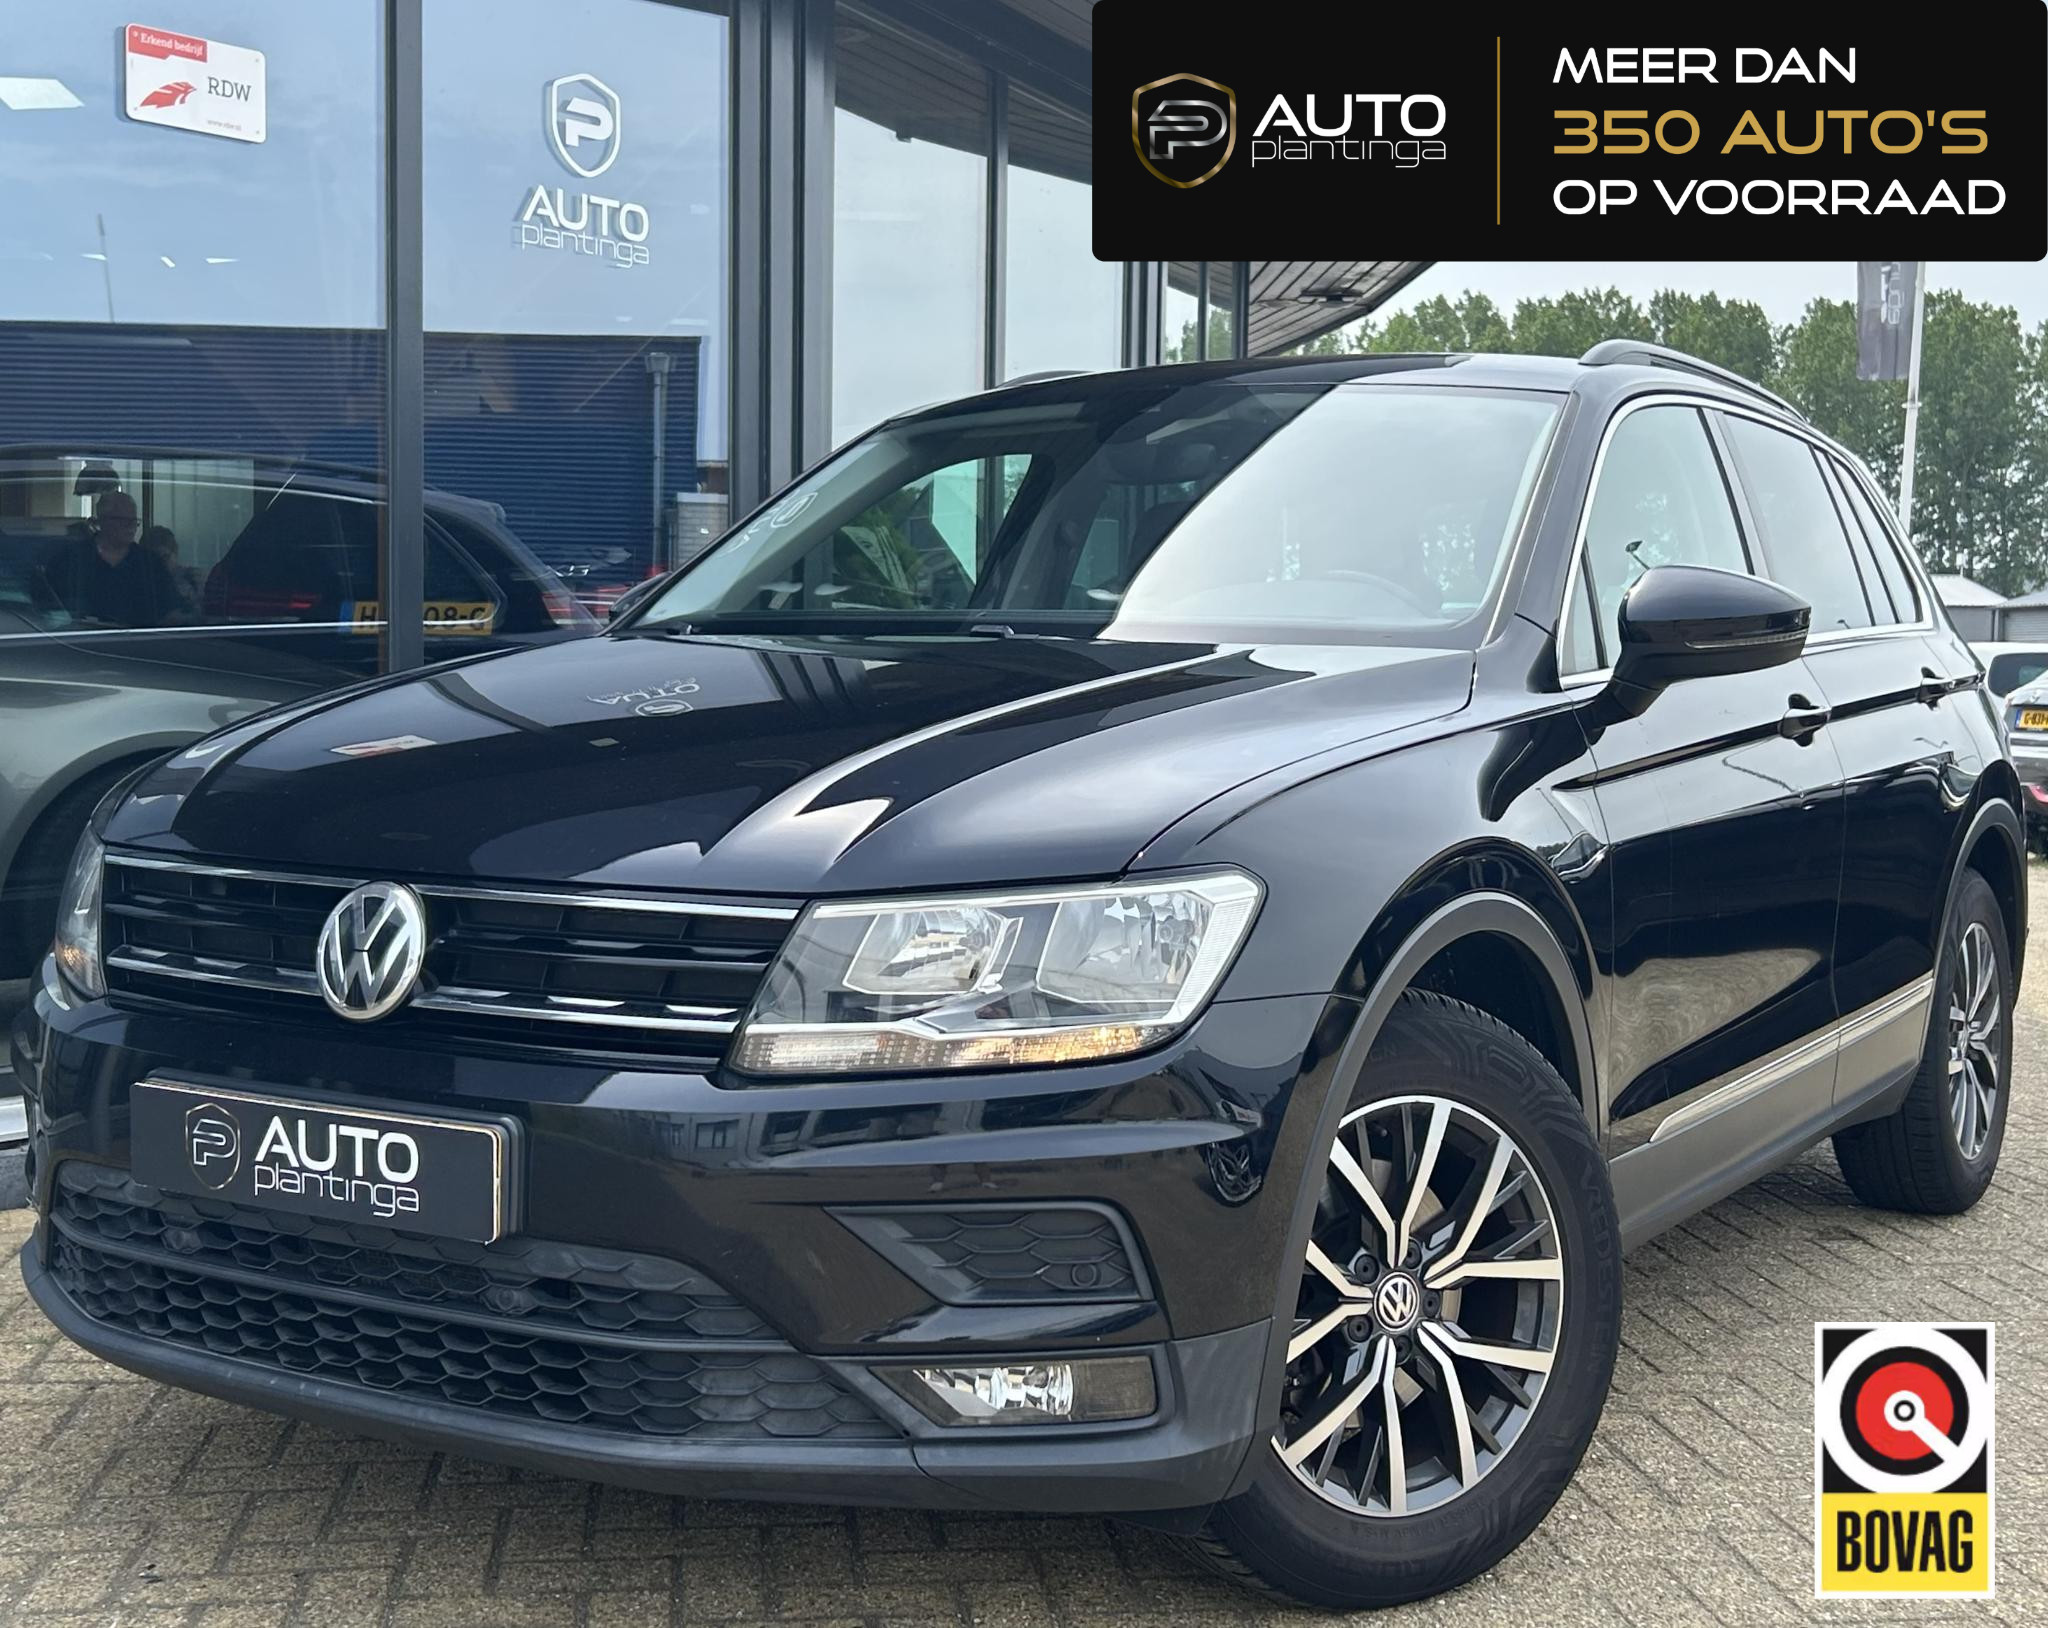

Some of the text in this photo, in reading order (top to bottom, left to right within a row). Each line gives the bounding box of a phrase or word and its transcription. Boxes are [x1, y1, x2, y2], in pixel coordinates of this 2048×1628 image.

[140, 32, 203, 57] Erkend bedrijf
[207, 76, 252, 102] RDW
[523, 185, 649, 242] AUTO
[522, 222, 650, 269] plantinga
[255, 1115, 420, 1184] AUTO
[254, 1164, 420, 1218] plantinga
